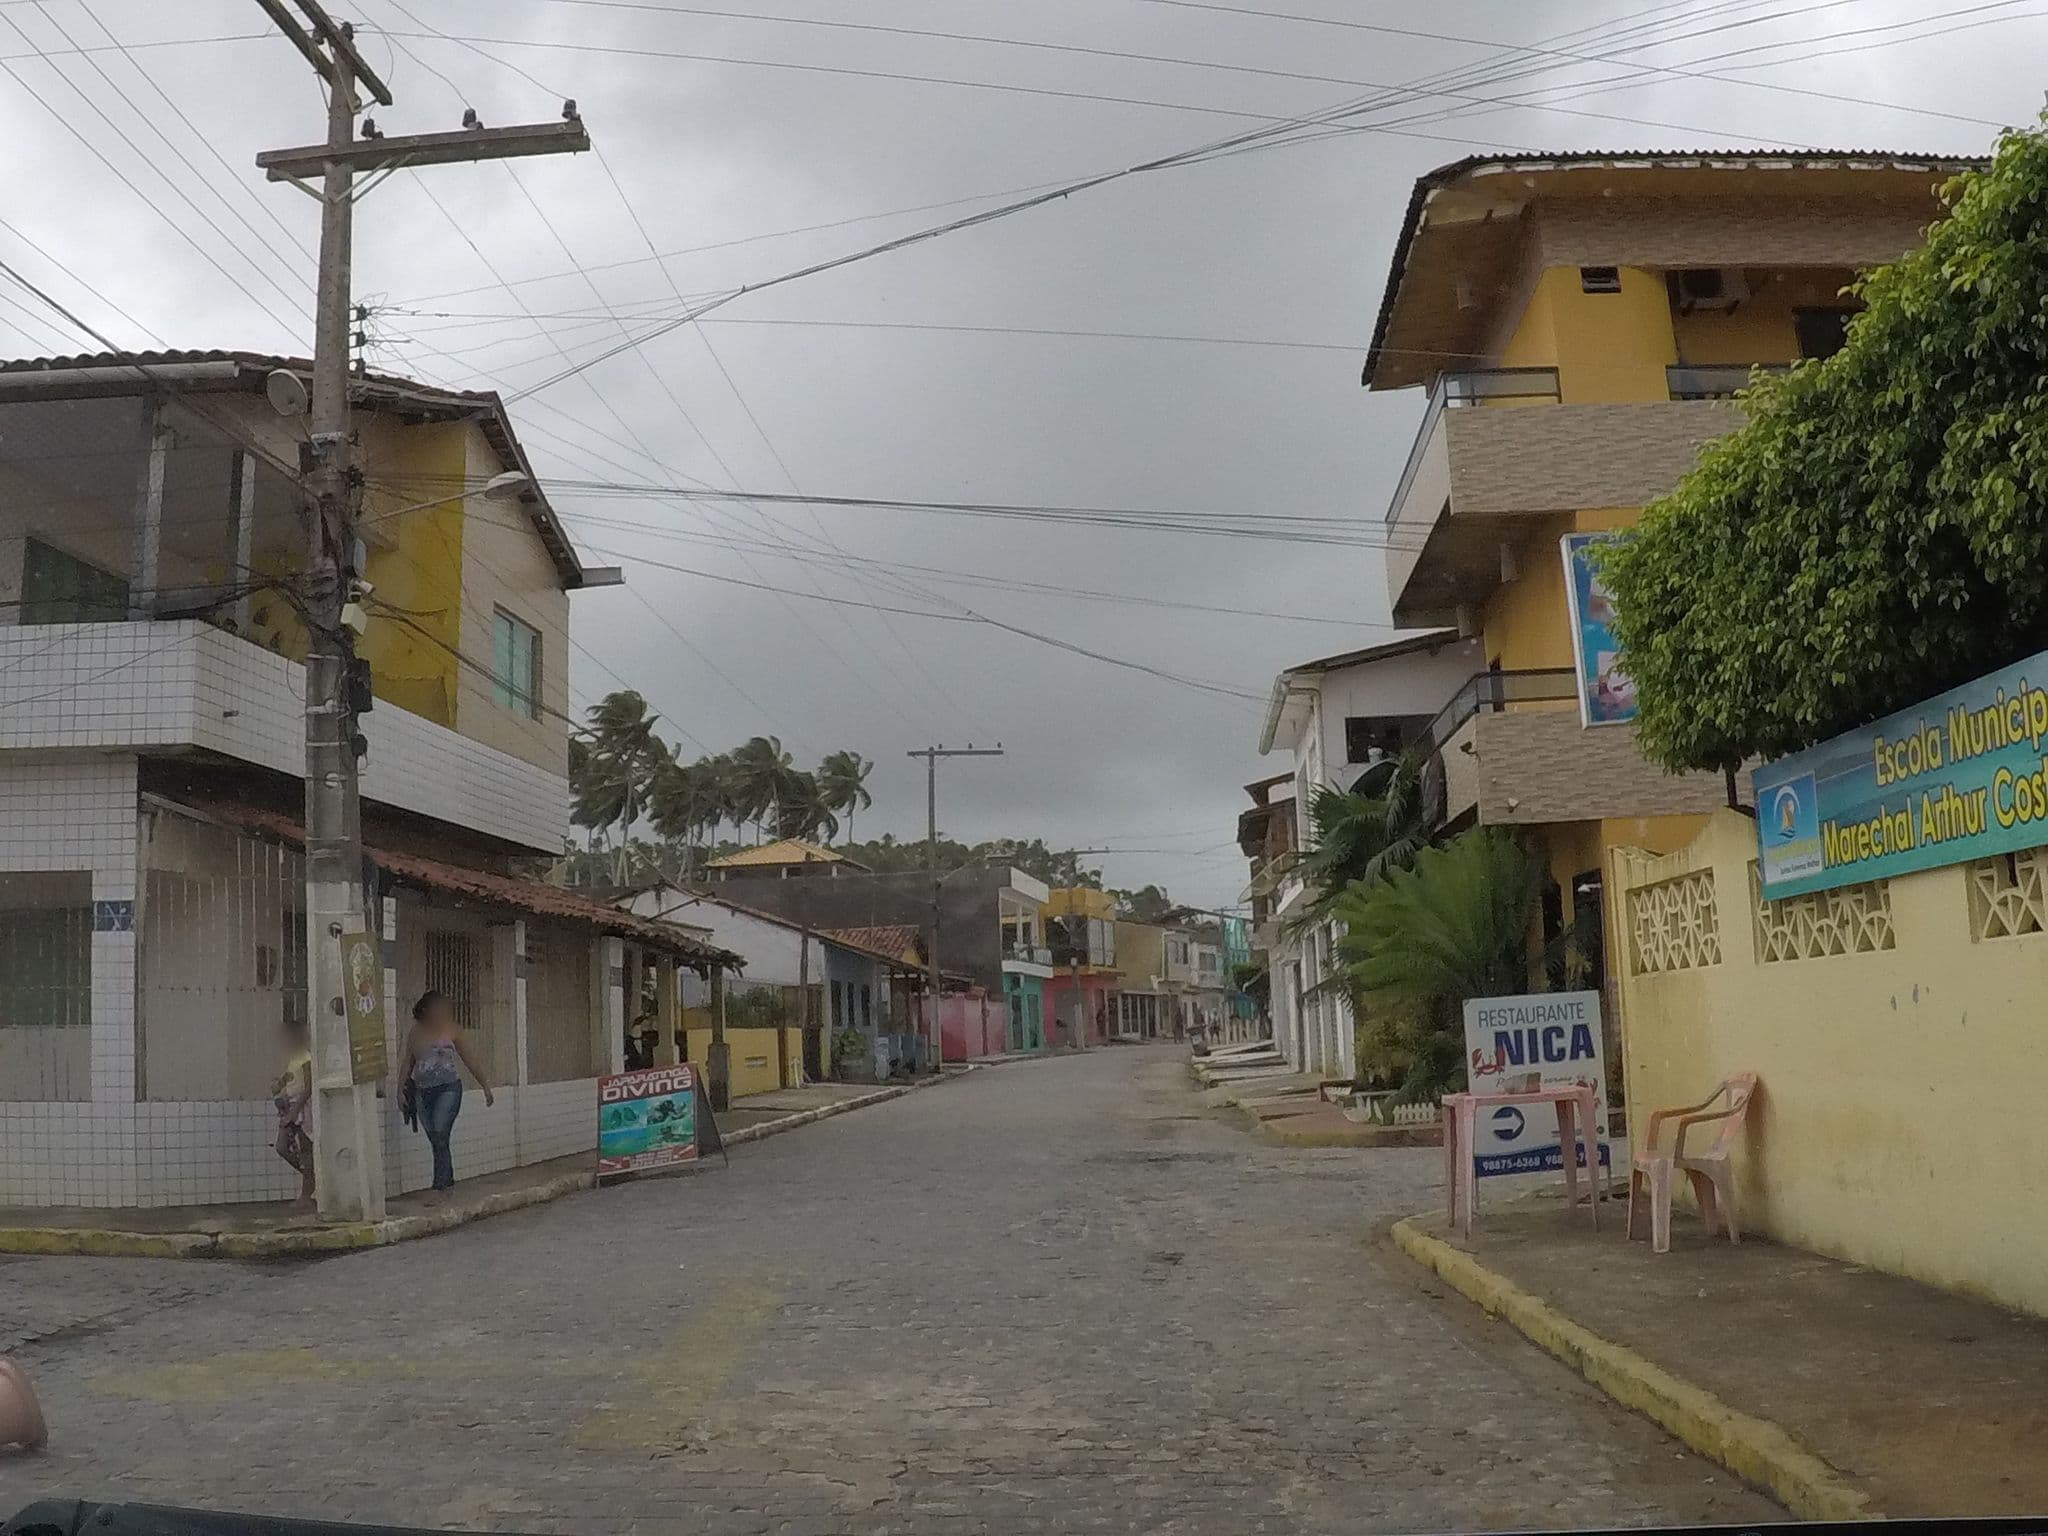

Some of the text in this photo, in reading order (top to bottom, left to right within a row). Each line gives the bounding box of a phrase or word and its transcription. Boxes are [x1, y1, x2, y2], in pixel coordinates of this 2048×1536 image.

[1874, 718, 1944, 788] Escola
[1822, 796, 1916, 870] Marechal
[1919, 782, 1988, 848] Arthur
[1478, 1001, 1585, 1028] RESTAURANTE
[1494, 1023, 1595, 1066] NICA
[602, 1075, 692, 1102] DIVING
